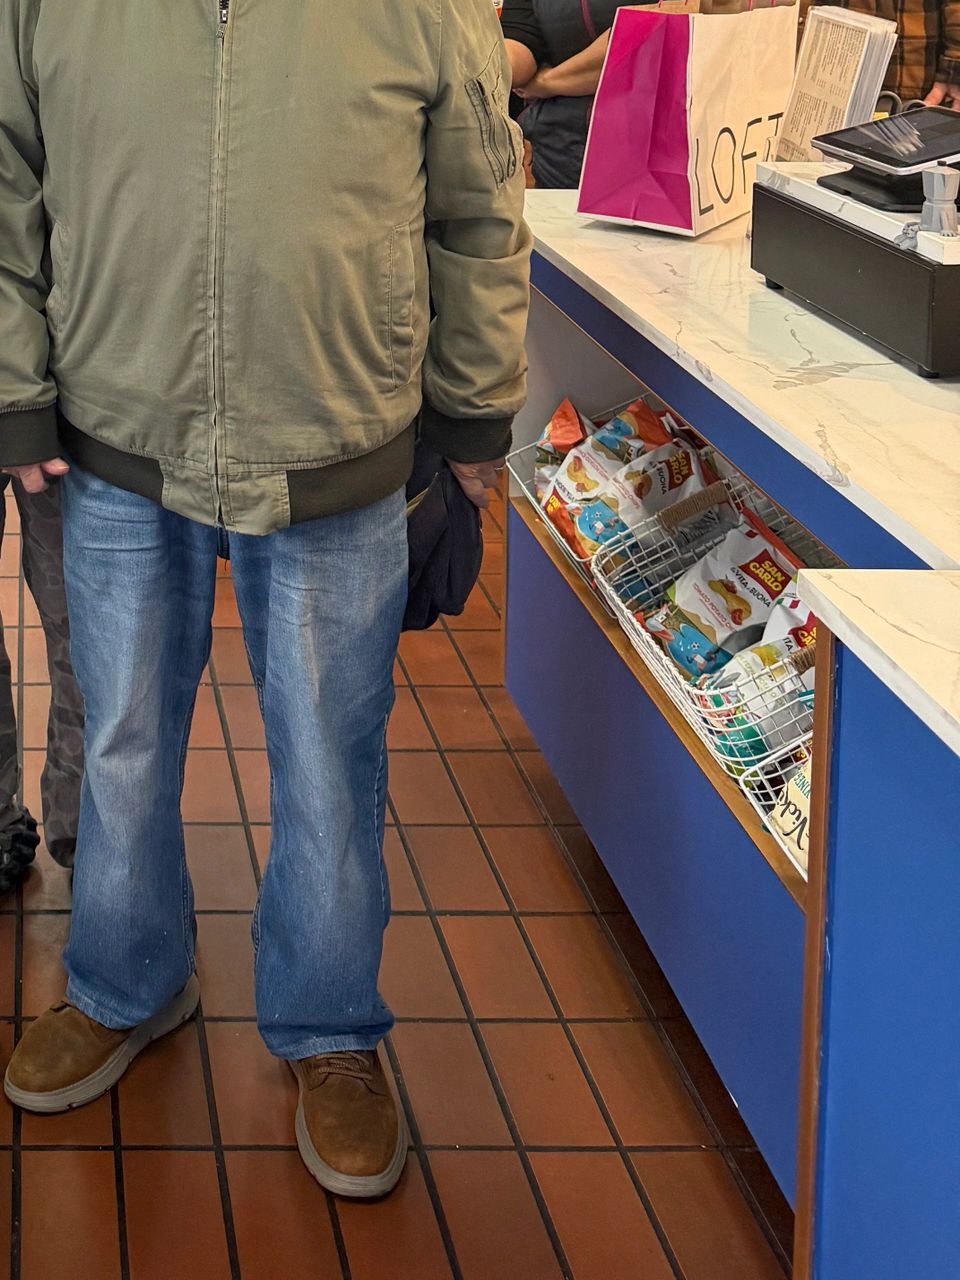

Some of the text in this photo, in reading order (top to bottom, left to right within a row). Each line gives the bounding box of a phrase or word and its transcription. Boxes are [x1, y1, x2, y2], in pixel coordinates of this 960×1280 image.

[695, 112, 784, 217] LOFT
[749, 561, 783, 592] CARLO
[761, 560, 786, 581] SAN
[749, 586, 772, 608] BUONA
